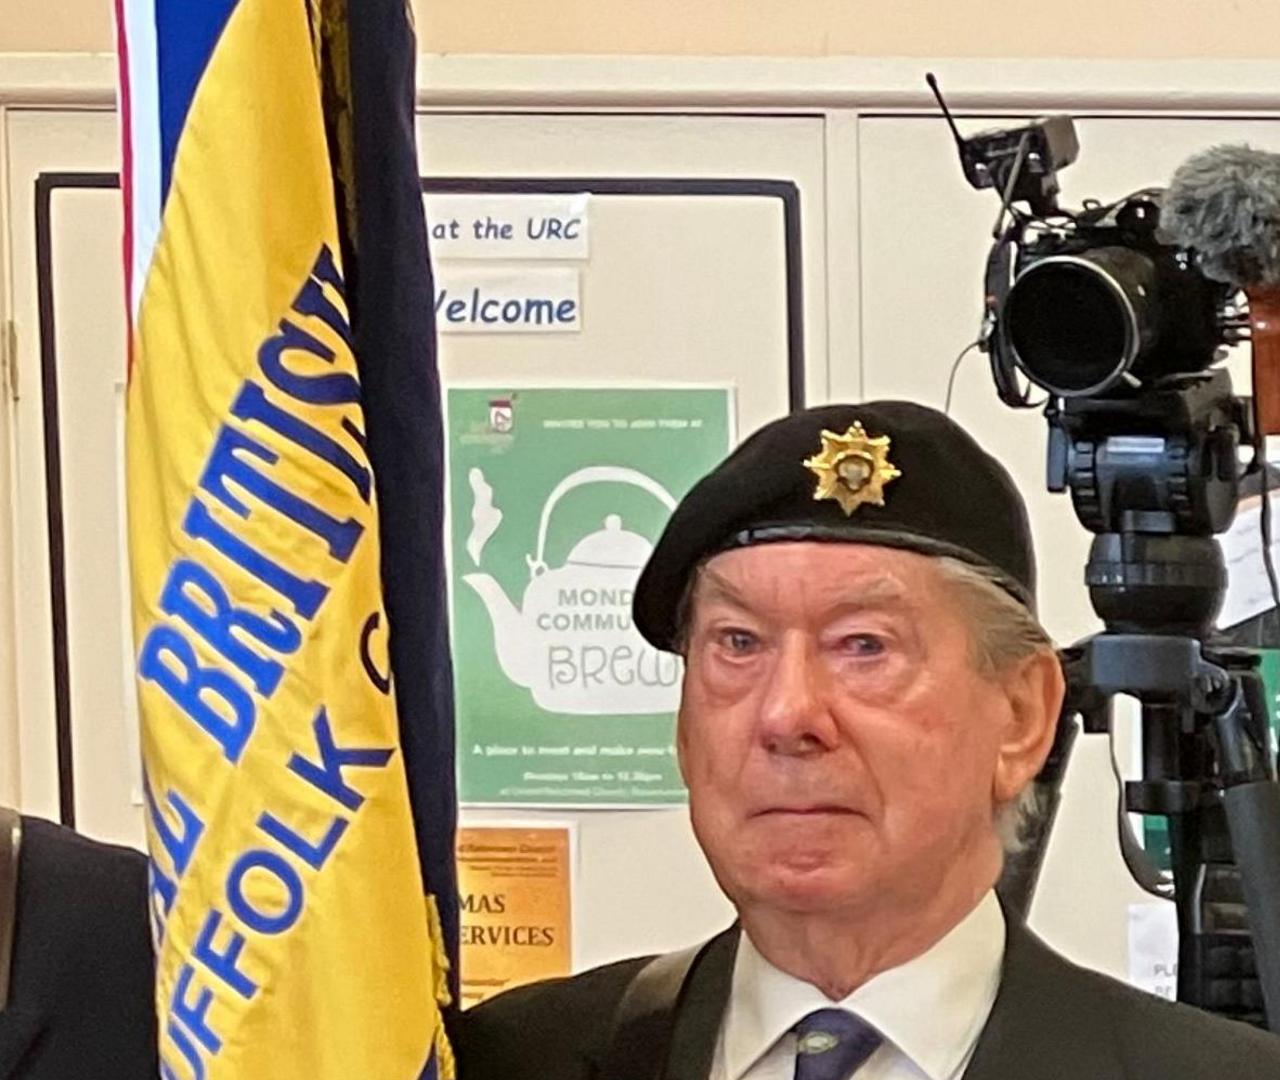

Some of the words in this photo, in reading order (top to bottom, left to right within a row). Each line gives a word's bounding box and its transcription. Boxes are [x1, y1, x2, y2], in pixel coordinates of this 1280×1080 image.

[432, 218, 459, 239] at
[473, 215, 513, 239] the
[527, 217, 581, 240] URC
[558, 588, 633, 606] MOND
[536, 612, 632, 631] COMMU
[459, 894, 506, 914] MAS
[460, 925, 556, 946] ERVICES
